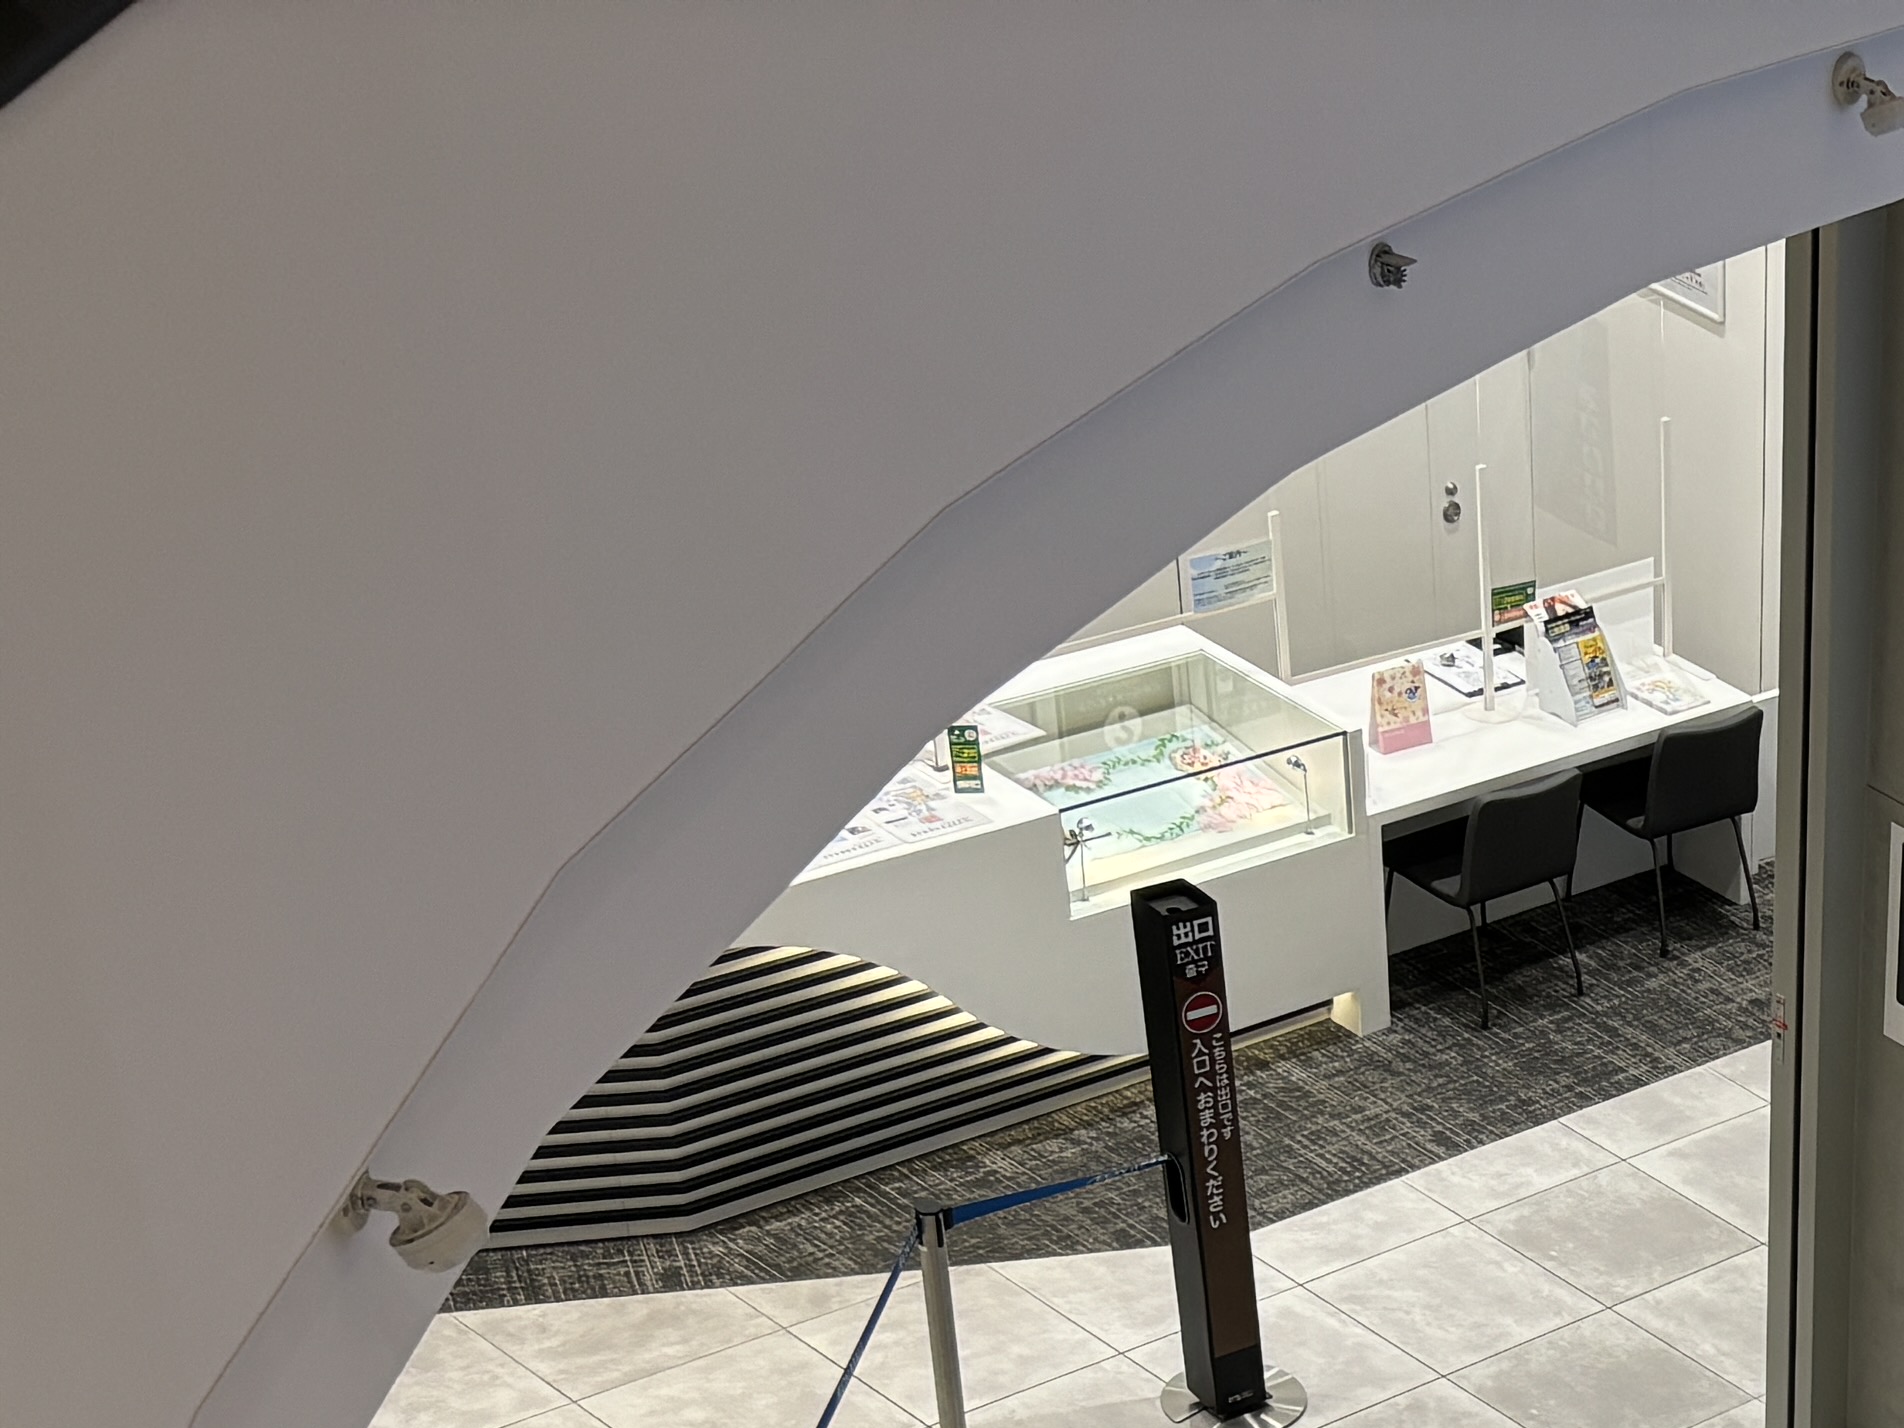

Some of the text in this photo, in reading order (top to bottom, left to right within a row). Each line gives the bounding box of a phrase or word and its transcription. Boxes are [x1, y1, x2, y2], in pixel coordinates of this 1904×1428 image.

[1171, 916, 1214, 947] 出口
[1175, 942, 1216, 966] EXIT
[1212, 1033, 1234, 1141] こちらは出口です
